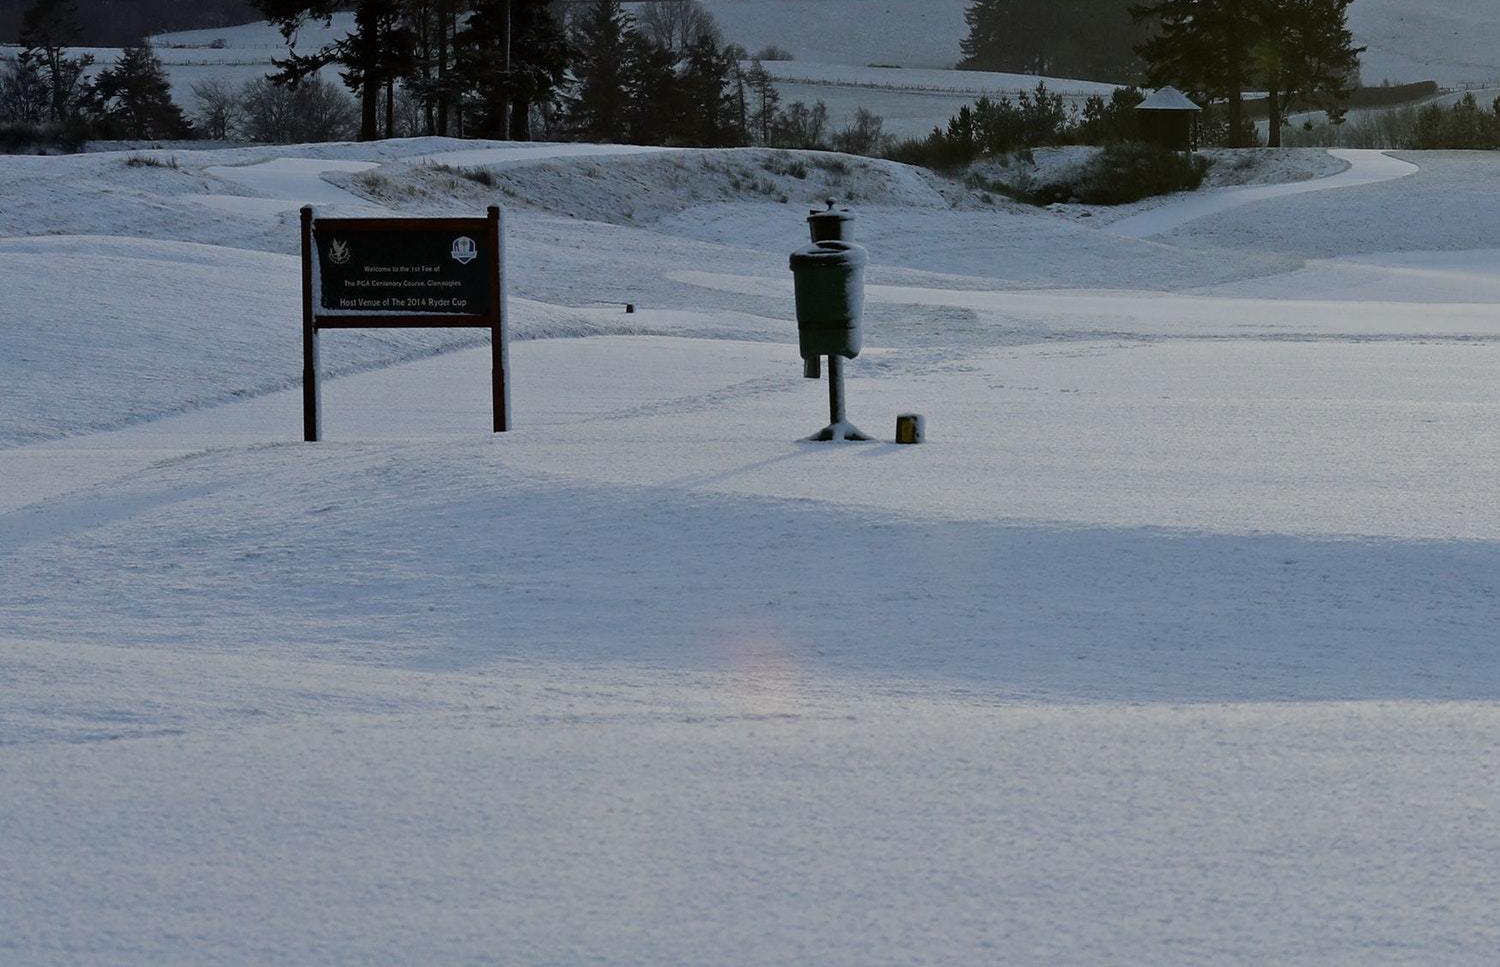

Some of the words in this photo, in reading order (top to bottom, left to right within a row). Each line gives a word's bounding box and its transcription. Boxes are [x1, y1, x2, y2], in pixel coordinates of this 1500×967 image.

[364, 265, 391, 273] Welcome
[399, 265, 409, 273] the
[421, 265, 433, 273] Tee
[433, 265, 440, 273] of
[340, 298, 356, 307] Host
[358, 298, 381, 307] Venue
[382, 298, 390, 307] of
[392, 298, 405, 307] The
[407, 298, 426, 306] 2014
[428, 298, 450, 307] Ryder
[451, 297, 467, 307] Cup
